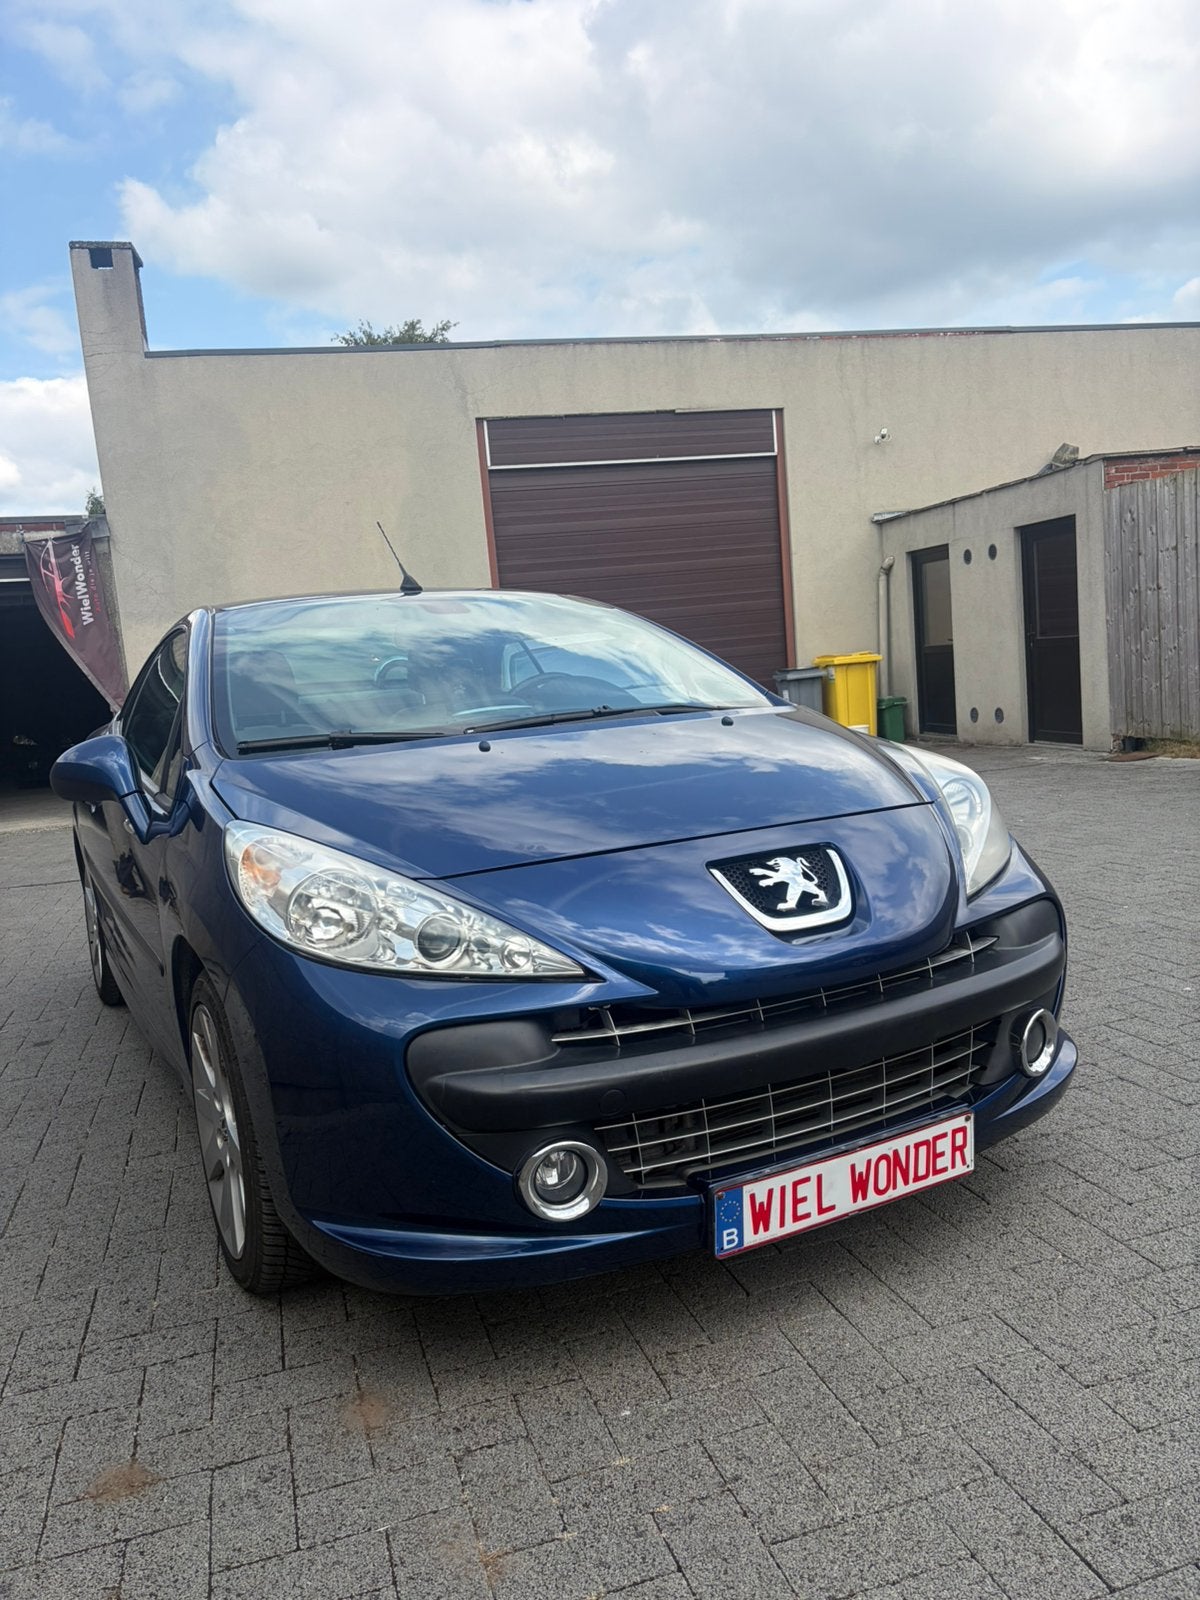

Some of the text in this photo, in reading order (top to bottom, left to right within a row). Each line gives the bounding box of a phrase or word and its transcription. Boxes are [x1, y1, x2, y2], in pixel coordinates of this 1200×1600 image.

[70, 544, 94, 625] WielWonder
[749, 1125, 968, 1235] WIEL WONDER
[723, 1228, 738, 1250] B
